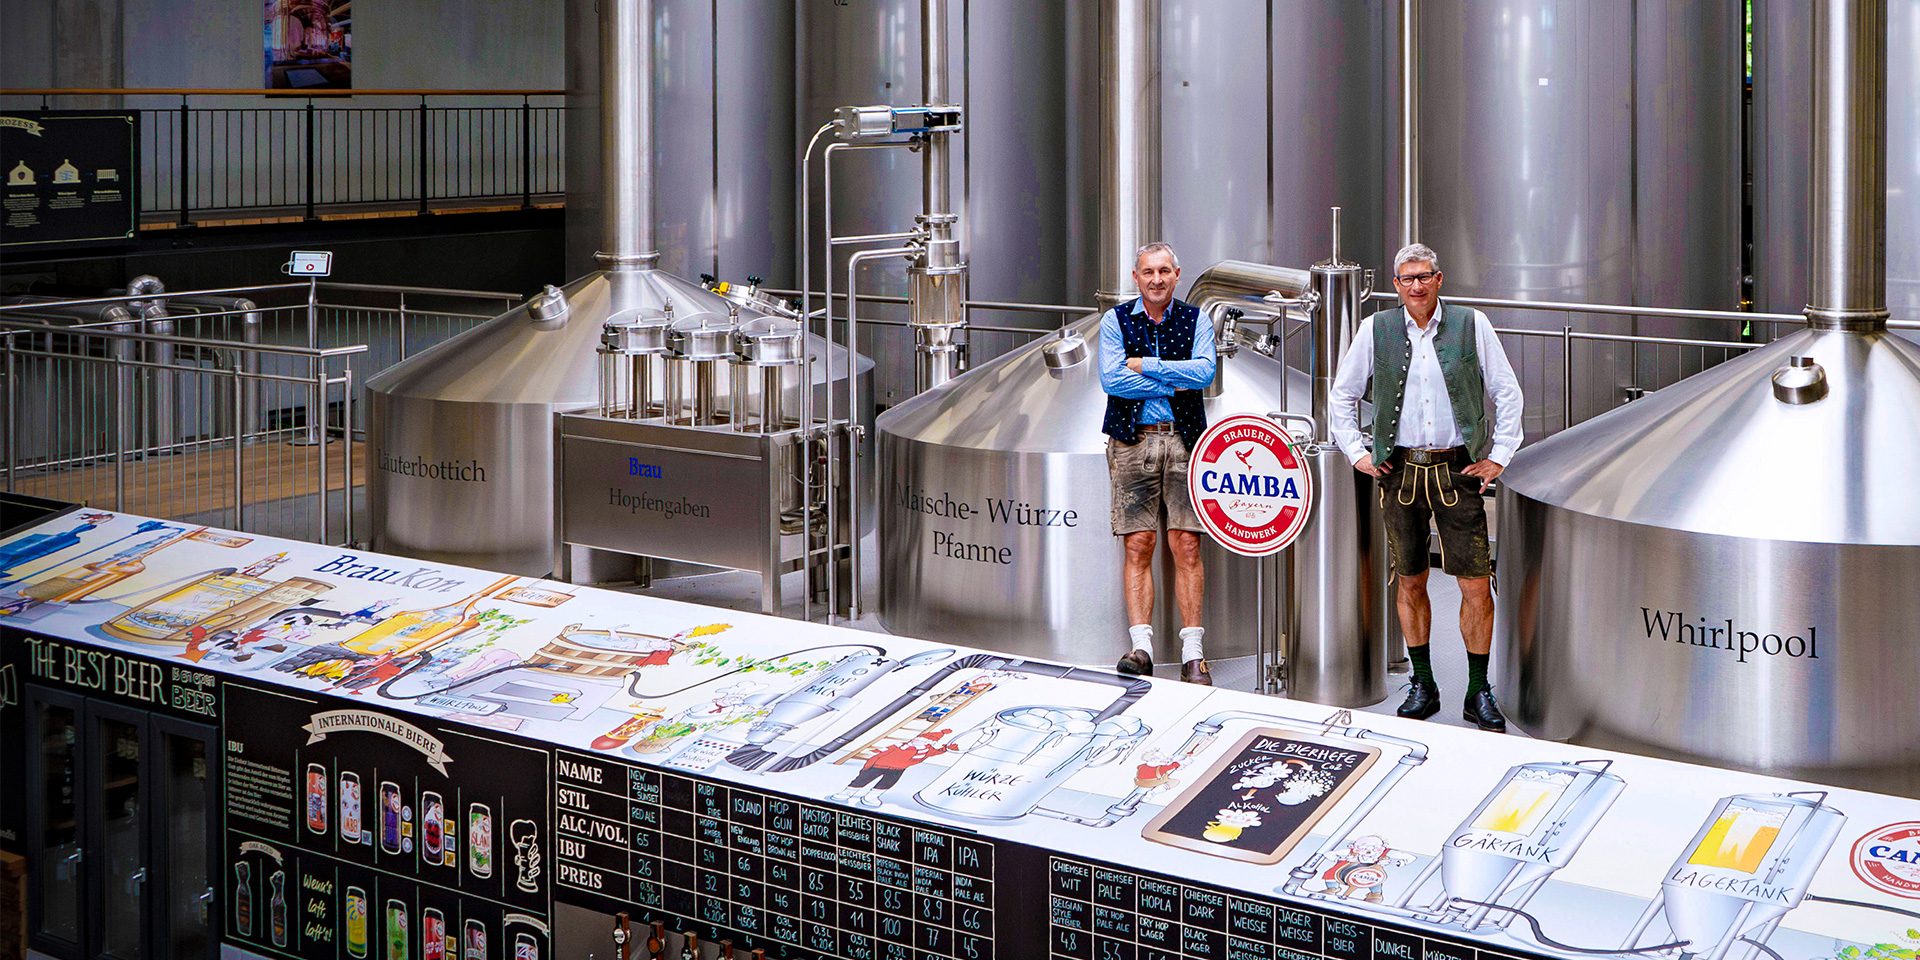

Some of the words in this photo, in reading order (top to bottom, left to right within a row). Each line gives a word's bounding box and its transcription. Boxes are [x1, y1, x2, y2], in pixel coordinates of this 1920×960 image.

[1223, 428, 1275, 446] BRAUEREI
[377, 448, 487, 482] Läuterbottich
[629, 456, 663, 479] Brau
[1202, 470, 1300, 499] CAMBA
[608, 487, 711, 520] Hopfengaben
[896, 483, 979, 520] Maische-
[986, 497, 1079, 527] Würze
[1224, 522, 1278, 539] HANDWERK
[932, 530, 1012, 565] Pfanne
[1640, 606, 1819, 663] Whirlpool
[24, 637, 60, 681] THE
[64, 645, 111, 691] BEST
[114, 656, 167, 705] BEER
[193, 671, 216, 691] open
[171, 684, 216, 717] BEER
[318, 713, 404, 737] INTERNATIONALE
[405, 727, 437, 754] BIERE
[227, 740, 244, 753] IBU
[1255, 738, 1280, 752] DIE
[1283, 743, 1358, 766] BIERHEFE
[559, 759, 603, 785] NAME
[1229, 755, 1273, 774] ZUCKER
[630, 769, 646, 782] NEW
[632, 782, 660, 795] ZEALAND
[698, 784, 716, 797] RUBY
[559, 788, 590, 811] STIL
[637, 791, 659, 804] SUNSET
[706, 799, 715, 808] ON
[631, 806, 645, 821] RED
[644, 810, 657, 824] ALE
[707, 808, 722, 819] FIRE
[734, 798, 762, 816] ISLAND
[769, 801, 790, 815] HOP
[773, 816, 793, 831] GUN
[801, 808, 836, 825] MASTRO-
[837, 813, 872, 832] LEICHTES
[559, 814, 628, 845] ALC./VOL.
[730, 825, 744, 836] NEW
[803, 825, 829, 840] BATOR
[838, 831, 871, 843] WEISSBIER
[876, 822, 901, 838] BLACK
[737, 835, 761, 848] ENGLAND
[767, 833, 780, 844] DRY
[780, 836, 794, 847] HOP
[876, 836, 901, 852] SHARK
[915, 830, 945, 848] IMPERIAL
[559, 838, 587, 860] IBU
[767, 844, 787, 857] BROWN
[786, 848, 797, 860] ALE
[838, 849, 872, 863] LEICHTES
[923, 847, 939, 864] IPA
[1454, 833, 1560, 863] GÄRTANK
[838, 858, 873, 872] WEISSBIER
[958, 846, 980, 868] IPA
[638, 858, 652, 877] 26
[915, 866, 944, 881] IMPERIAL
[1052, 860, 1090, 878] CHIEMSEE
[560, 863, 603, 890] PREIS
[705, 874, 717, 892] 32
[915, 877, 932, 887] INDIA
[955, 876, 972, 888] INDIA
[1060, 876, 1082, 892] WIT
[1095, 870, 1134, 885] CHIEMSEE
[739, 884, 751, 898] 30
[915, 885, 930, 895] PALE
[932, 888, 944, 898] ALE
[1098, 884, 1123, 900] PALE
[1139, 879, 1178, 896] CHIEMSEE
[1672, 867, 1794, 904] LAGERTANK
[775, 893, 788, 908] 46
[955, 888, 971, 901] PALE
[973, 892, 985, 903] ALE
[1141, 894, 1172, 913] HOPLA
[1184, 889, 1224, 907] CHIEMSEE
[811, 900, 825, 919] 19
[1052, 897, 1083, 912] BELGIAN
[1189, 904, 1215, 920] DARK
[1229, 899, 1273, 919] WILDERER
[643, 911, 650, 923] 1
[850, 911, 864, 929] 11
[1052, 907, 1072, 919] STYLE
[1095, 907, 1109, 919] DRY
[1110, 910, 1125, 921] HOP
[676, 917, 683, 931] 2
[882, 917, 901, 937] 100
[1052, 916, 1082, 929] WITBIER
[1096, 919, 1113, 930] PALE
[1116, 922, 1130, 933] ALE
[1139, 916, 1153, 929] DRY
[1155, 920, 1169, 931] HOP
[1233, 916, 1268, 934] WEISSE
[711, 926, 718, 939] 3
[926, 927, 939, 947] 77
[1140, 928, 1165, 942] LAGER
[1184, 928, 1208, 942] BLACK
[1279, 926, 1315, 943] WEISSE
[745, 935, 753, 948] 4
[963, 937, 979, 959] 45
[1184, 941, 1211, 954] LAGER
[1229, 938, 1266, 954] DUNKLES
[1375, 938, 1414, 960] DUNKEL
[780, 945, 787, 957] 5
